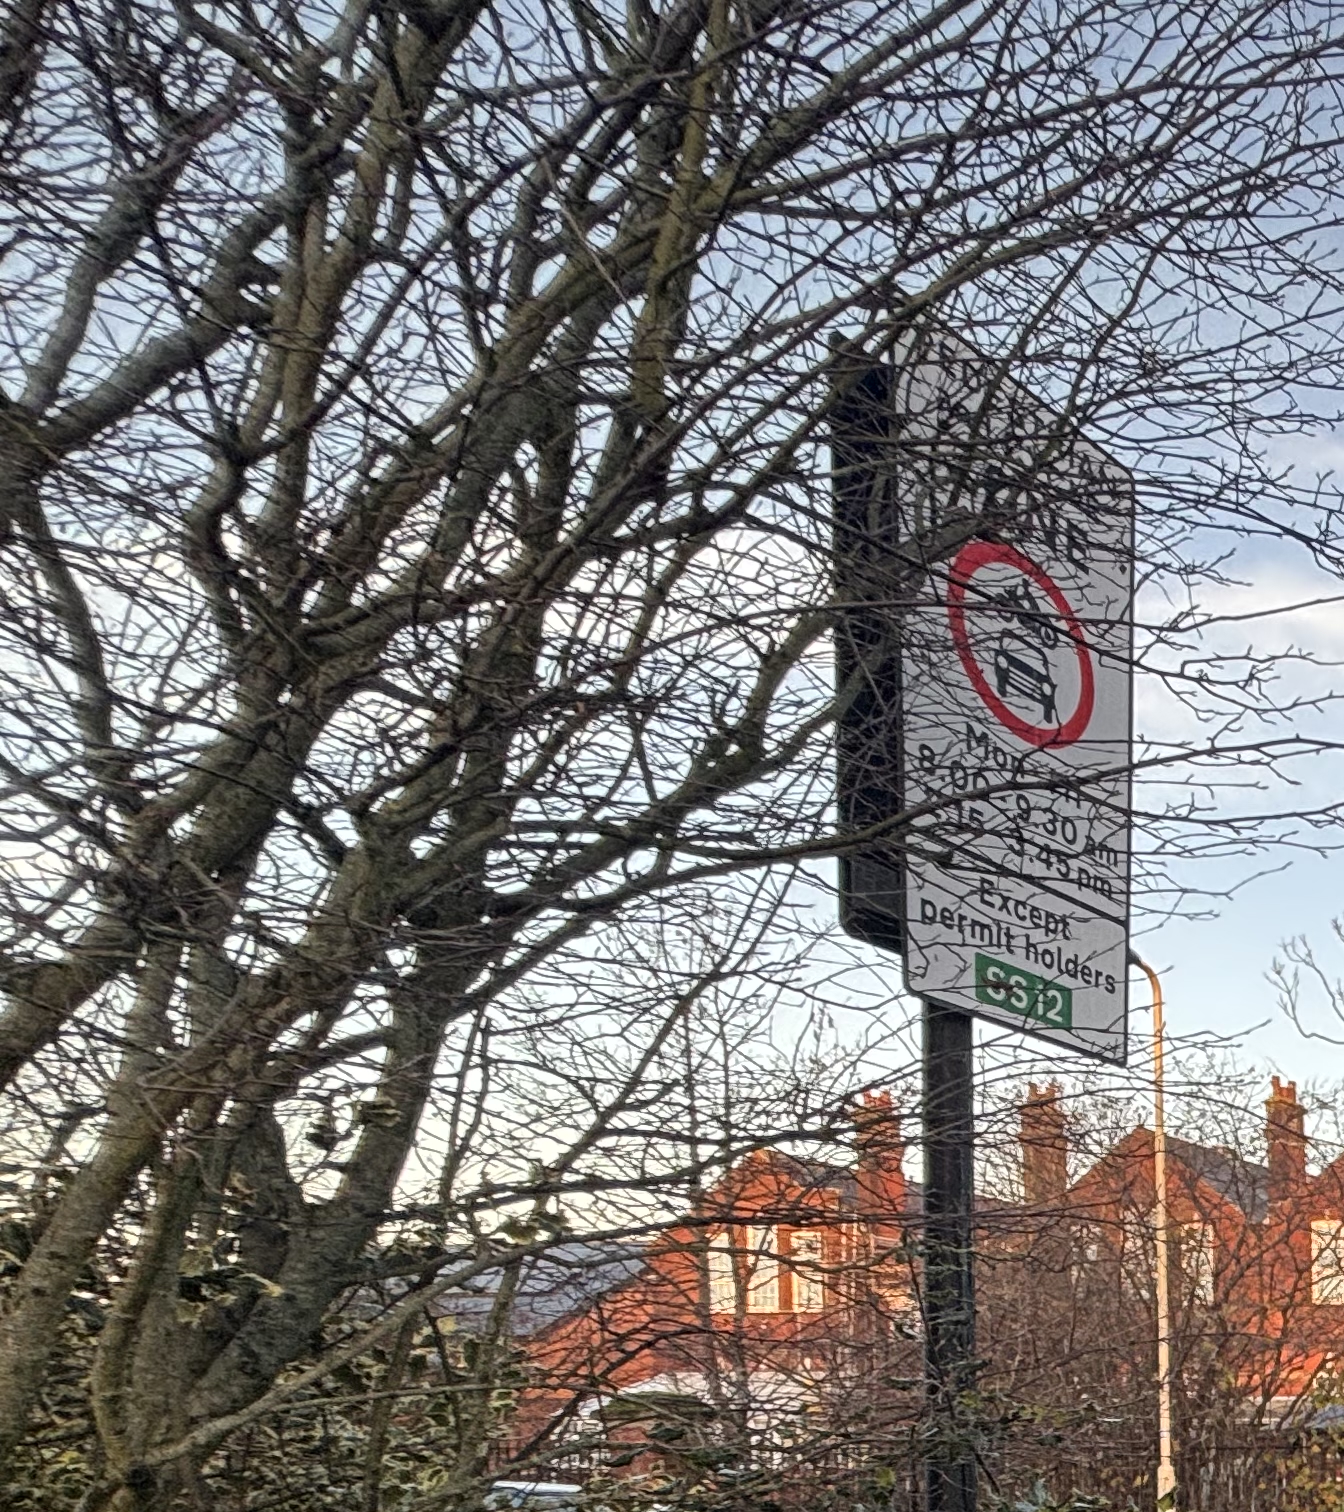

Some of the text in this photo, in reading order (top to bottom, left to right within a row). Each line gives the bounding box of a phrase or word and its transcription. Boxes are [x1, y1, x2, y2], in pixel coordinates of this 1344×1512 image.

[920, 898, 1117, 994] permit holders
[979, 876, 1071, 941] Except
